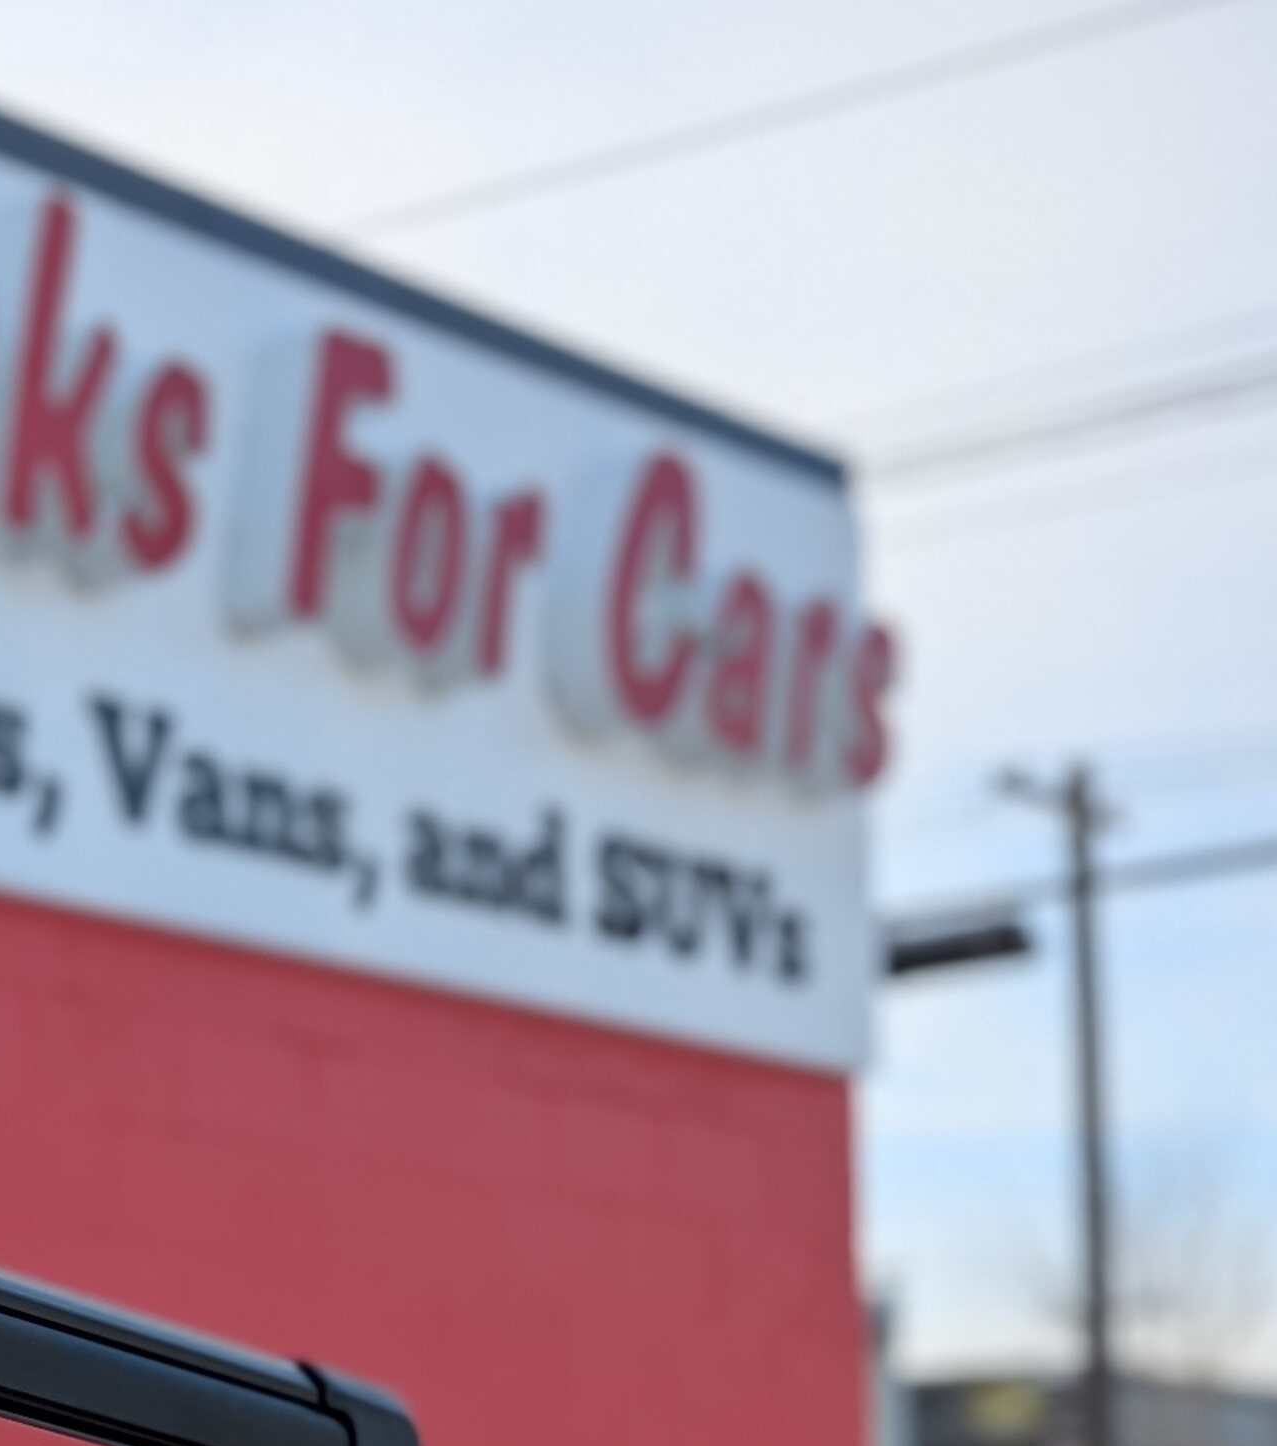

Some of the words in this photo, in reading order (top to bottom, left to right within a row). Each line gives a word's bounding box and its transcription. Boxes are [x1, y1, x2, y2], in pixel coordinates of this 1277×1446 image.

[289, 325, 545, 682] For
[611, 447, 903, 792] Cars
[88, 692, 380, 906] Vans,
[404, 806, 569, 928] and
[595, 832, 811, 986] SUVs
